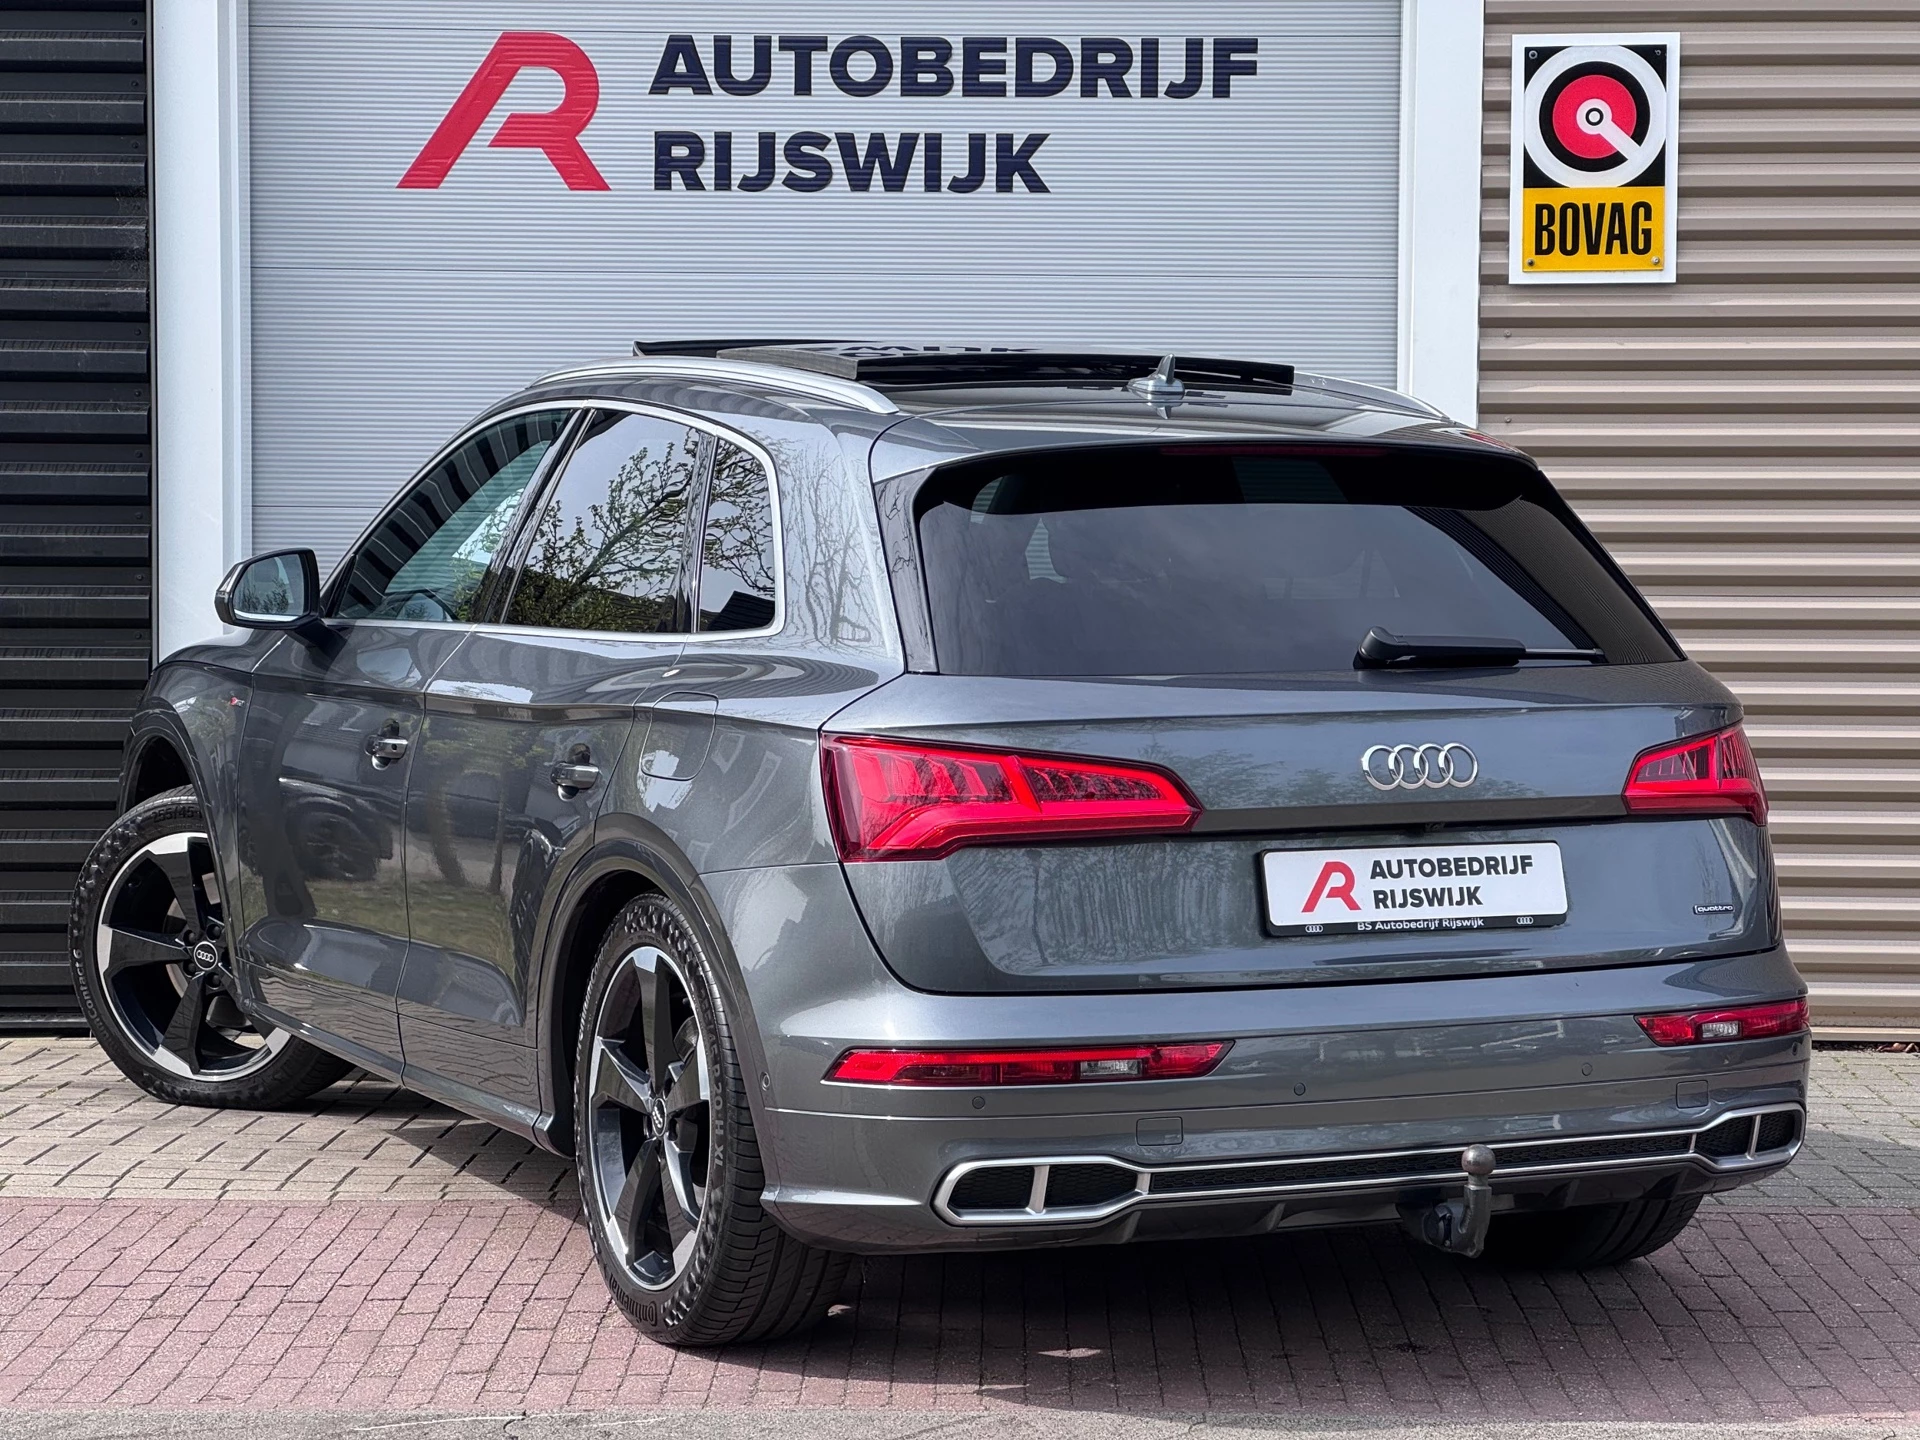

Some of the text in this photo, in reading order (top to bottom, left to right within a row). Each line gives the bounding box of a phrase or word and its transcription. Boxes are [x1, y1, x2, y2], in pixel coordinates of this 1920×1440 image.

[649, 34, 1259, 99] AUTOBEDRIJF
[653, 131, 1051, 194] RIJSWIJK
[1534, 201, 1652, 256] BOVAG
[1370, 854, 1533, 880] AUTOBEDRIJF
[1373, 886, 1483, 910] RIJSWIJK
[1697, 905, 1733, 913] quattro
[1357, 917, 1485, 931] BS Autobedrijf Rijswijk
